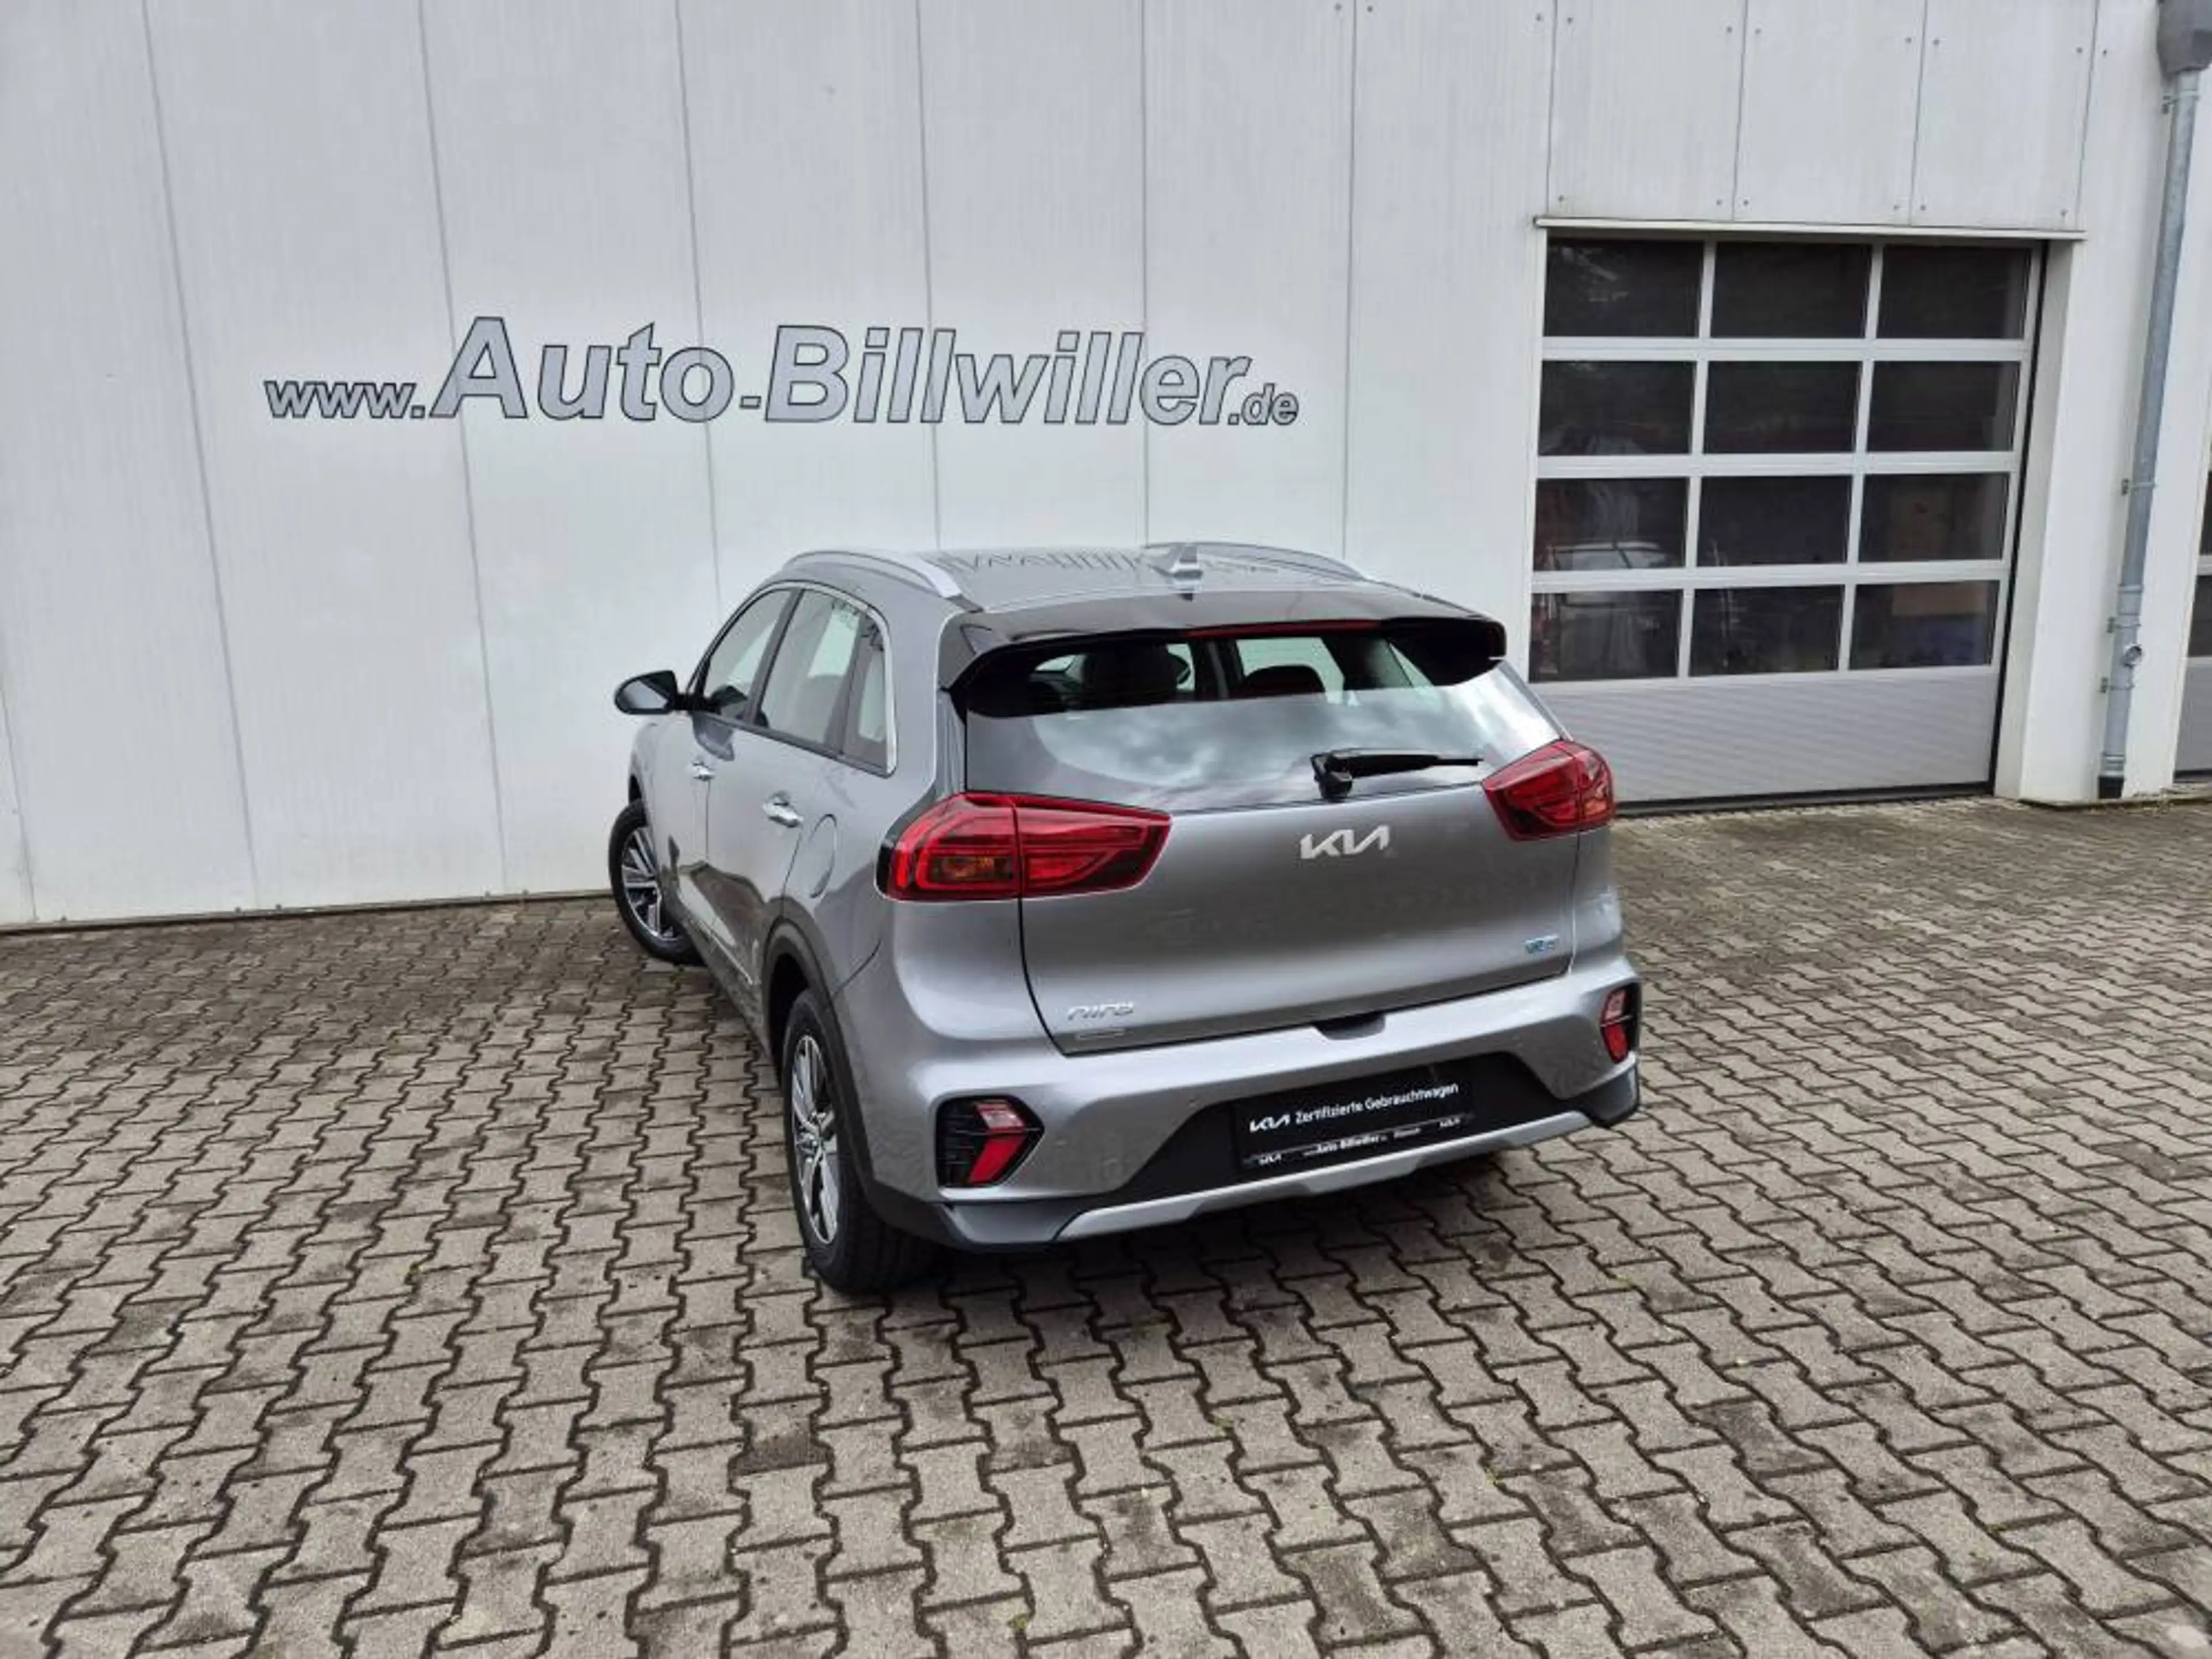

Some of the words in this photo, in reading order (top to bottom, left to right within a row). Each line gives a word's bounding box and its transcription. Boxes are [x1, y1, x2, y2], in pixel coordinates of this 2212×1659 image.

[263, 316, 1300, 426] www.Auto-Billwiller.de
[1300, 824, 1391, 859] KIA
[1295, 1100, 1363, 1125] Zertifizierte
[1365, 1082, 1459, 1111] Gebrauchtwagen
